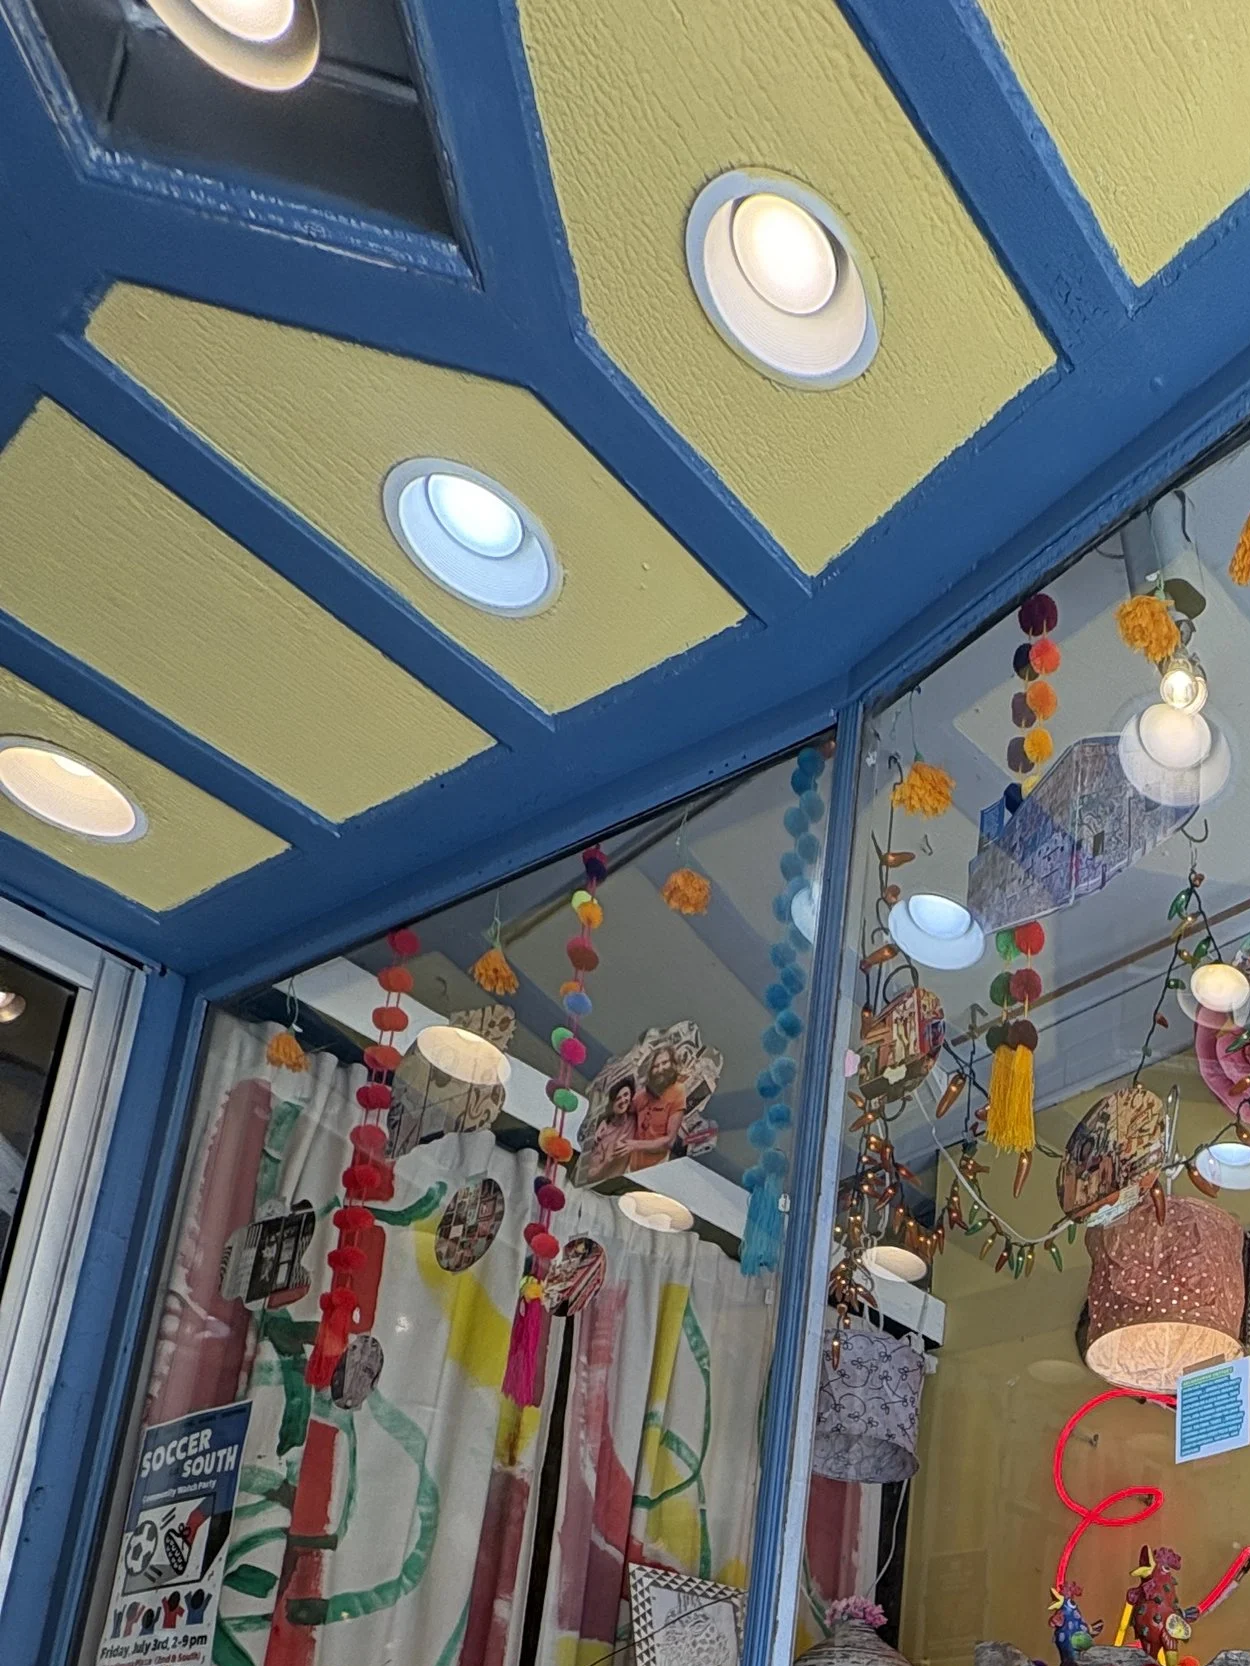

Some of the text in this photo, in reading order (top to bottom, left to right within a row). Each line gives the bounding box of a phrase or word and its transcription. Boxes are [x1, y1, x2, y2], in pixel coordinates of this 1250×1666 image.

[141, 1428, 212, 1478] SOCCER
[181, 1444, 239, 1478] SOUTH
[177, 1482, 198, 1495] Watch
[198, 1479, 217, 1491] Party
[130, 1640, 152, 1656] July
